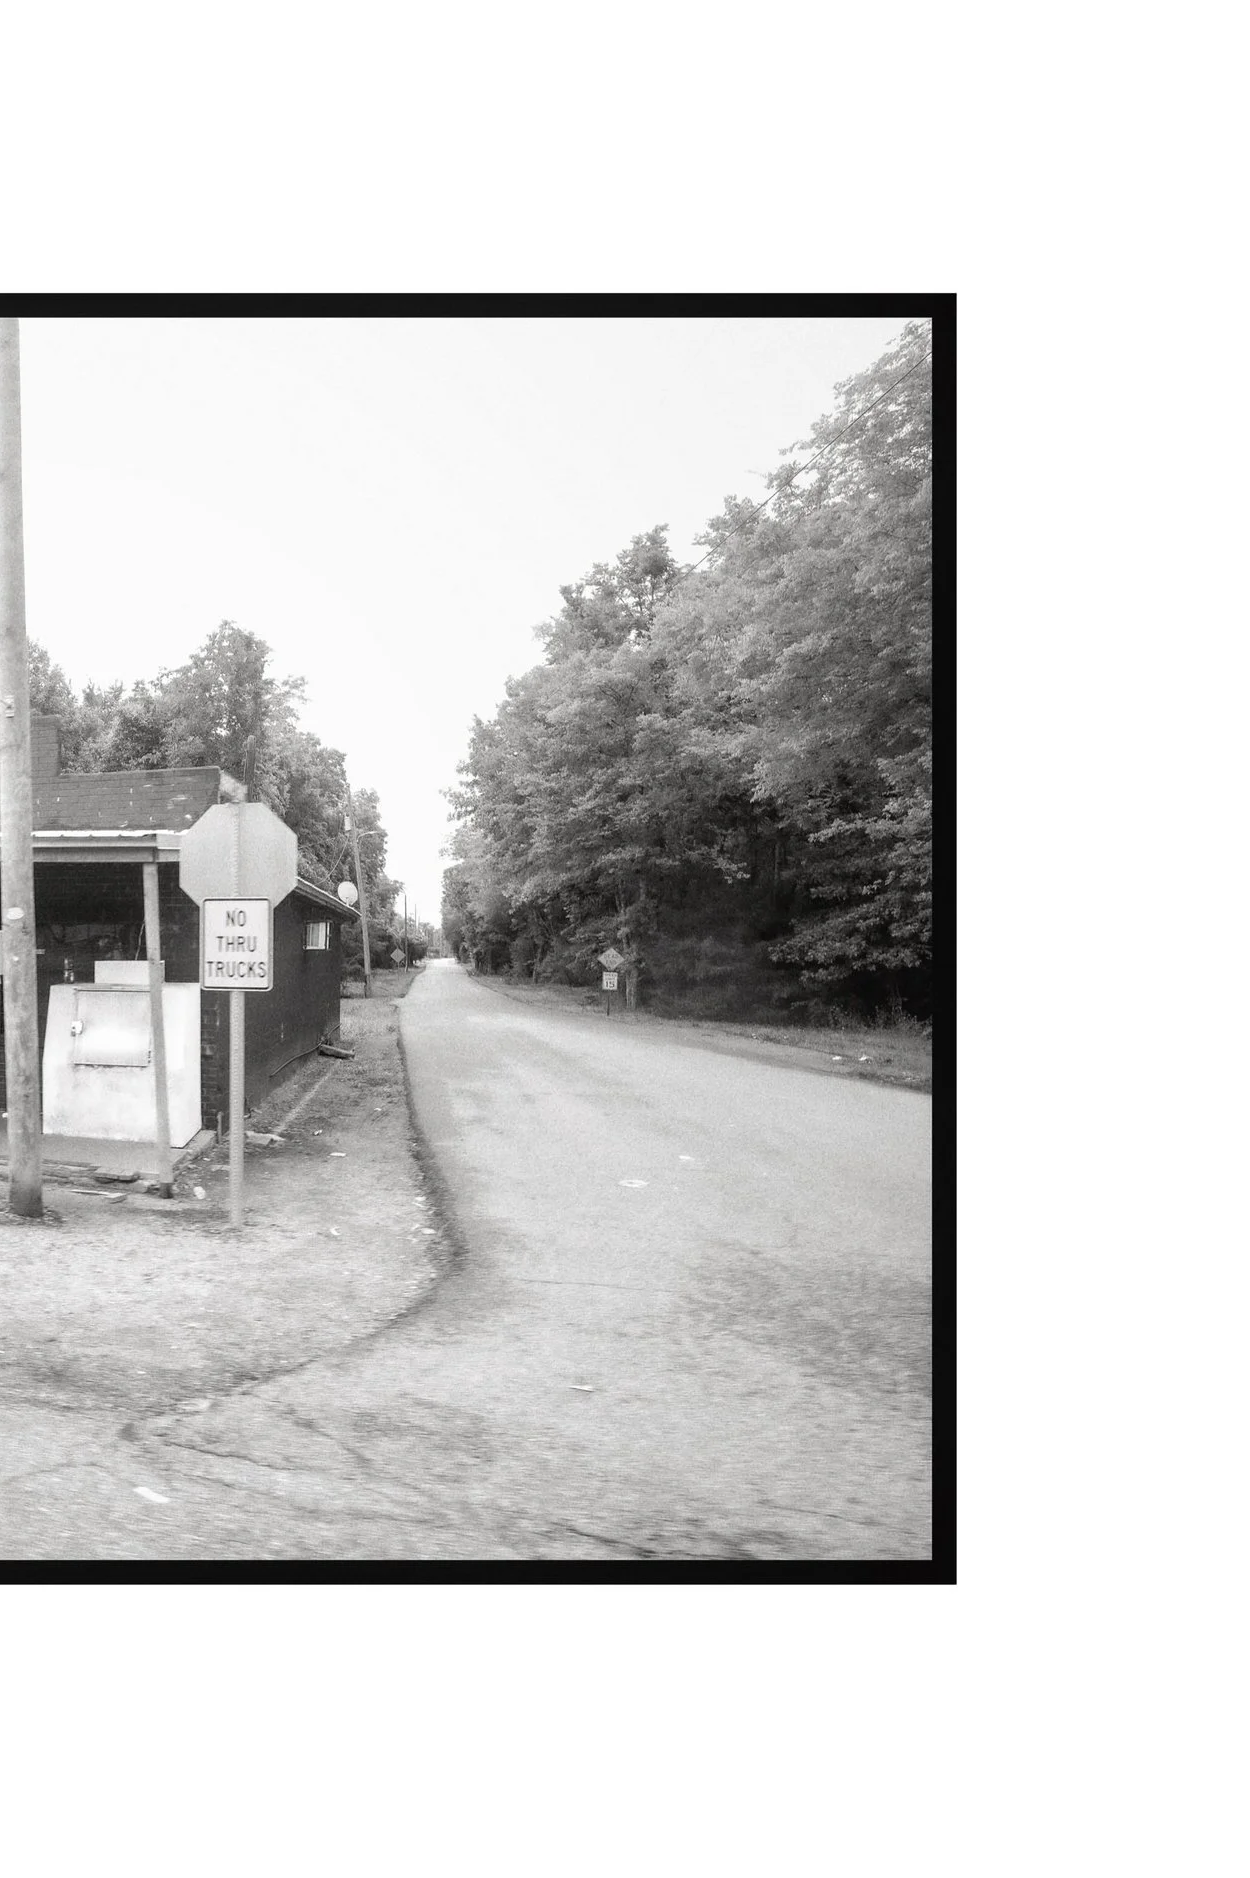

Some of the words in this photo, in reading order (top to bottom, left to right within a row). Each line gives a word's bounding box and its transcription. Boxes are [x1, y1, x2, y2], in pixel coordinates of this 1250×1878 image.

[225, 910, 247, 927] NO
[216, 935, 258, 953] THRU
[206, 961, 267, 978] TRUCKS
